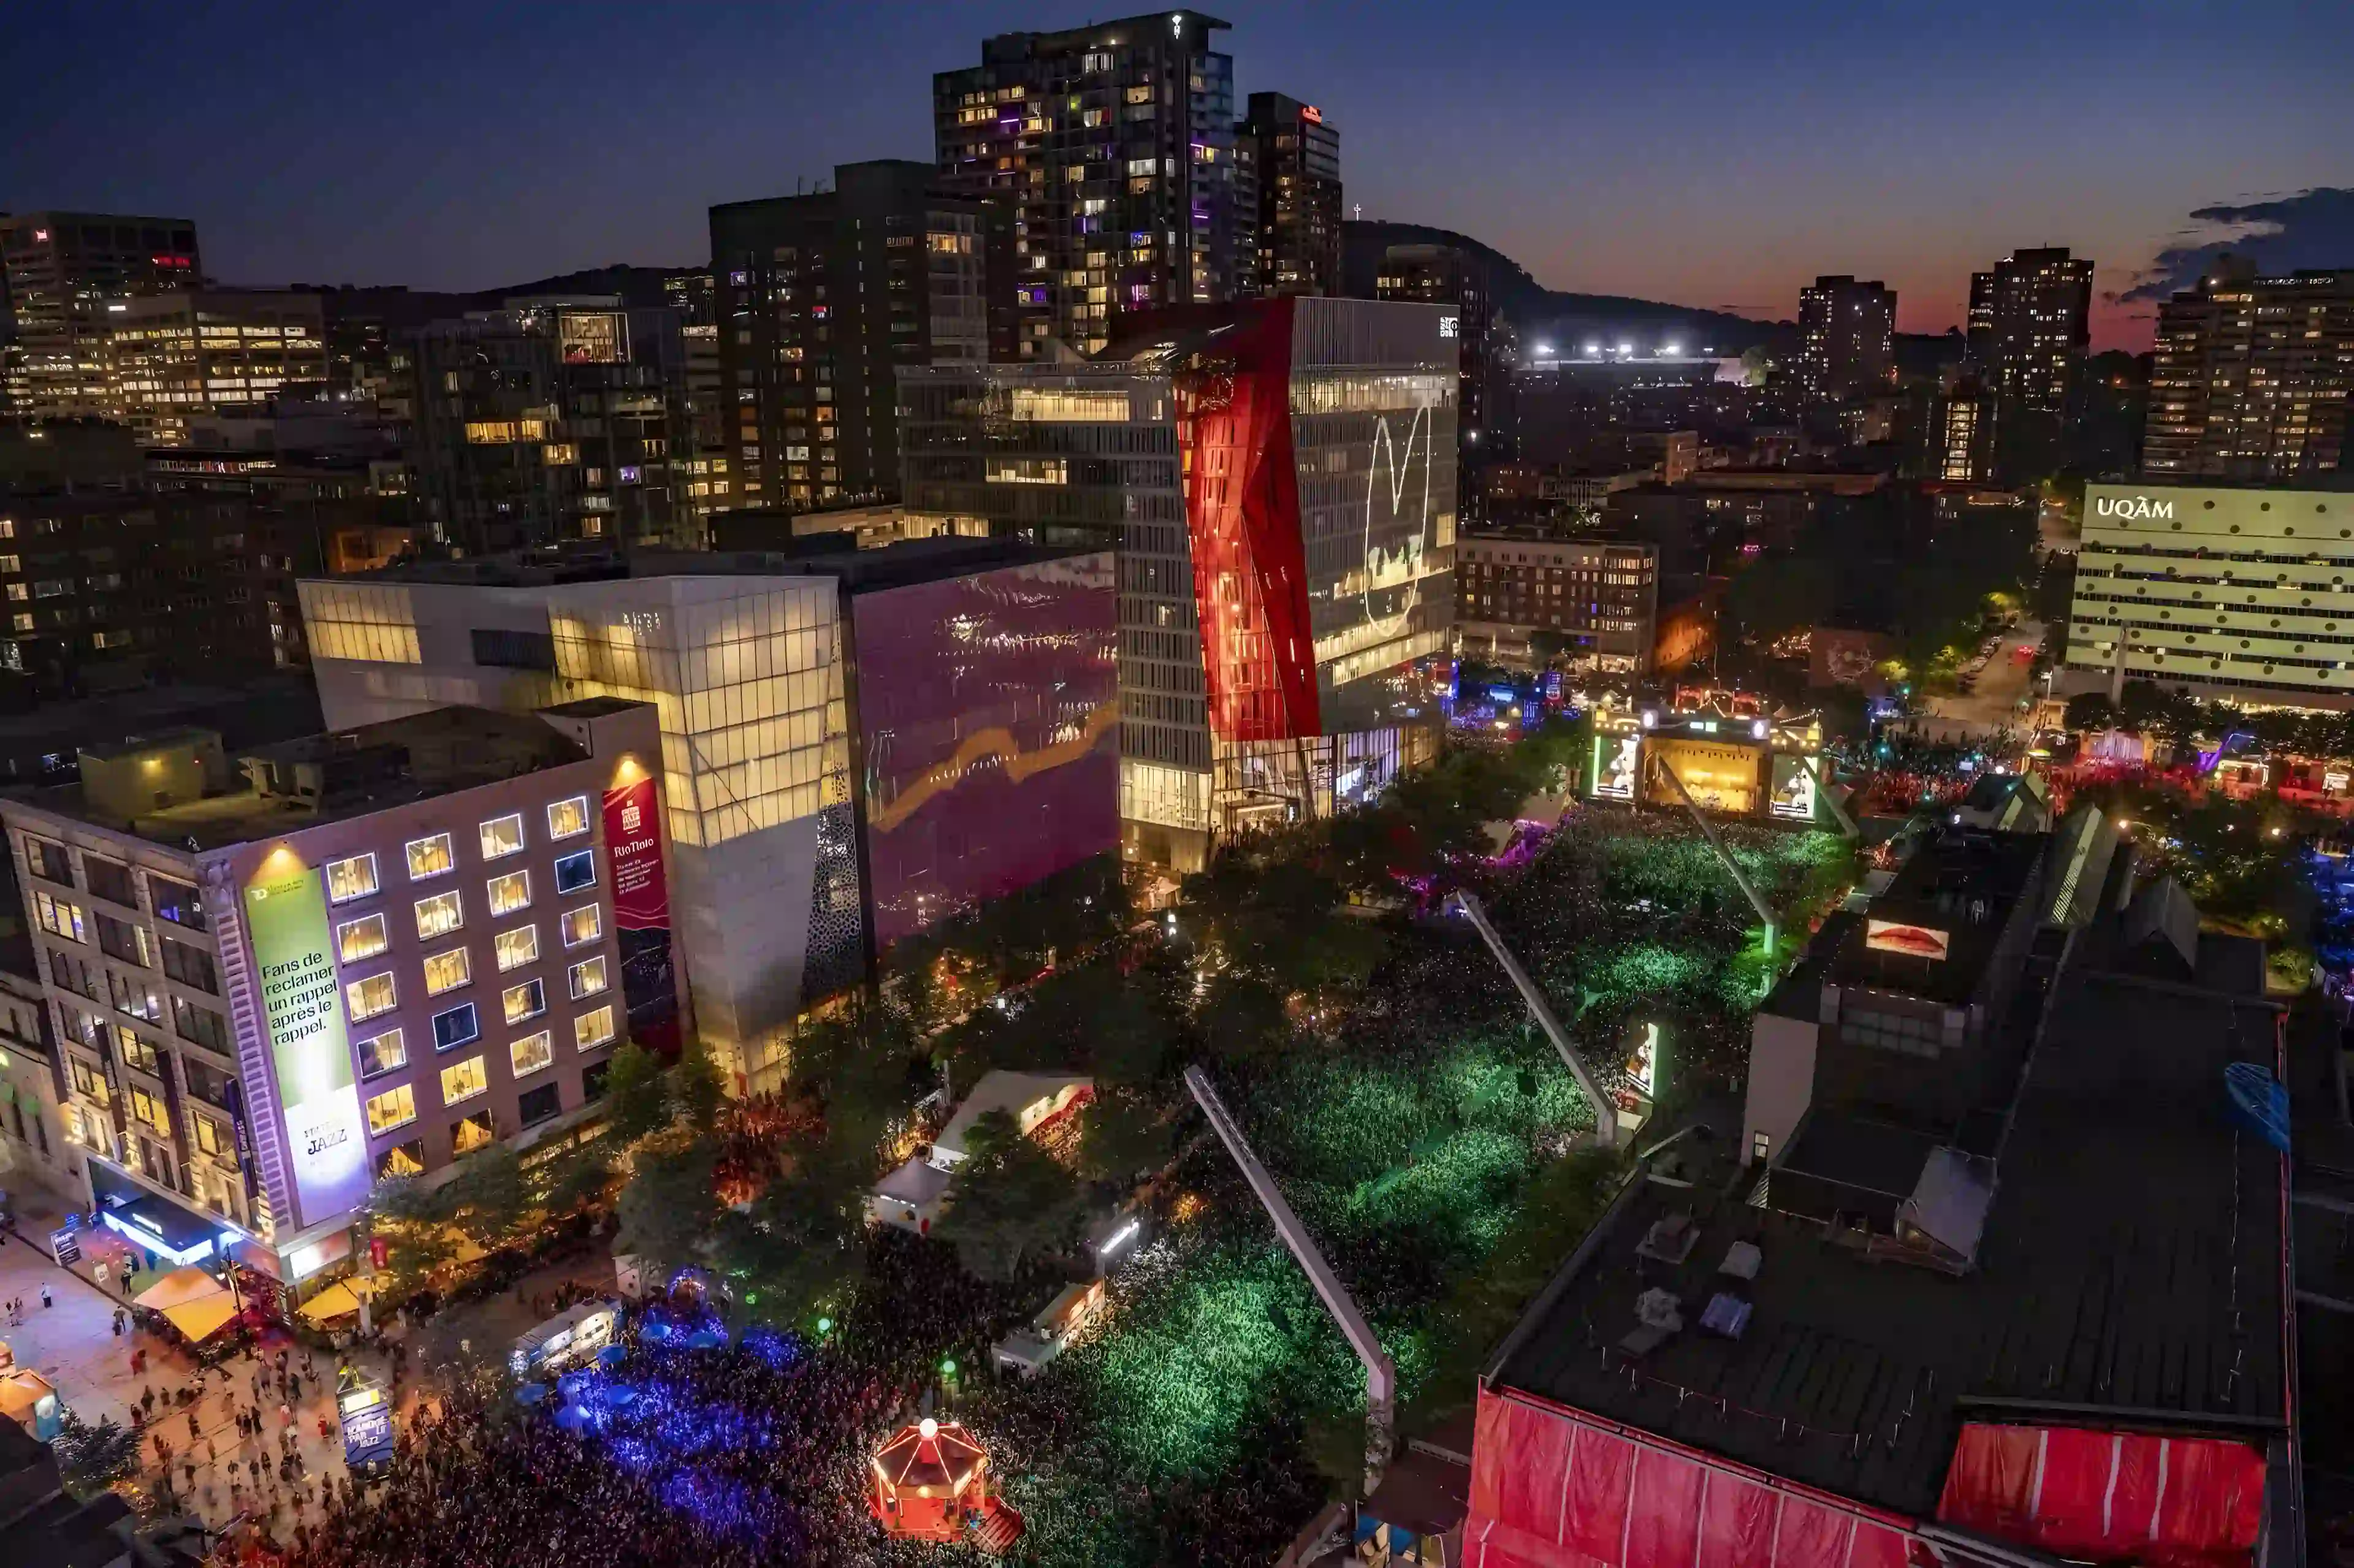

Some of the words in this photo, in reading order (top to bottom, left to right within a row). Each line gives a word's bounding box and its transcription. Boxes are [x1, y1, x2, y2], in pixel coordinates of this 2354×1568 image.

[2097, 495, 2173, 520] UQÀM
[262, 960, 300, 980] Fans
[303, 953, 322, 967] de
[265, 965, 335, 996] réclamer
[269, 999, 288, 1013] un
[291, 979, 338, 1006] rappel
[272, 1006, 315, 1029] après
[319, 1000, 332, 1013] le
[275, 1018, 327, 1046] rappel.
[308, 1128, 347, 1155] JAZZ
